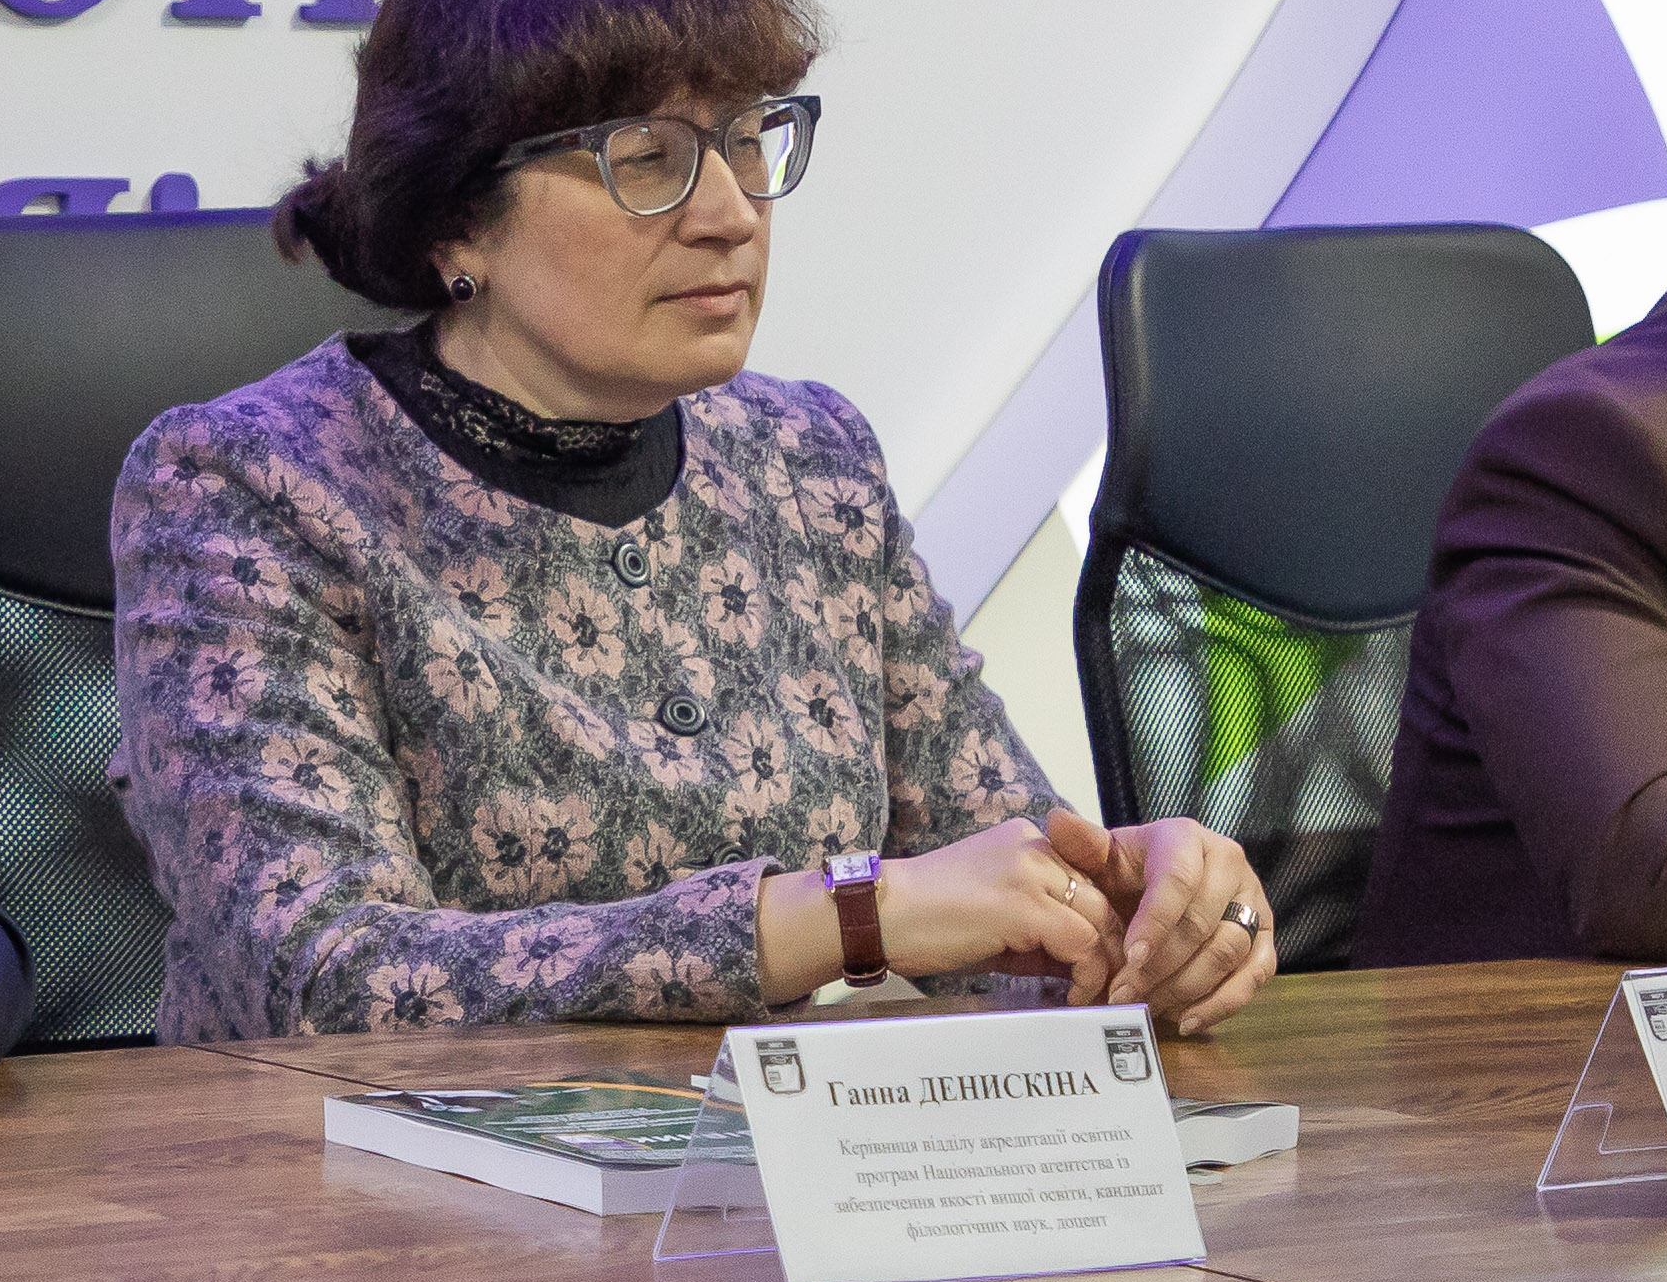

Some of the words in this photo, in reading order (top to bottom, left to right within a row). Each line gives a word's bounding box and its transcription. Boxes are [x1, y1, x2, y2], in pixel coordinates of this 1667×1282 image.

[827, 1081, 911, 1107] Ганна
[919, 1071, 1100, 1108] ДЕНИСКІНА
[1072, 1127, 1133, 1145] освітніх
